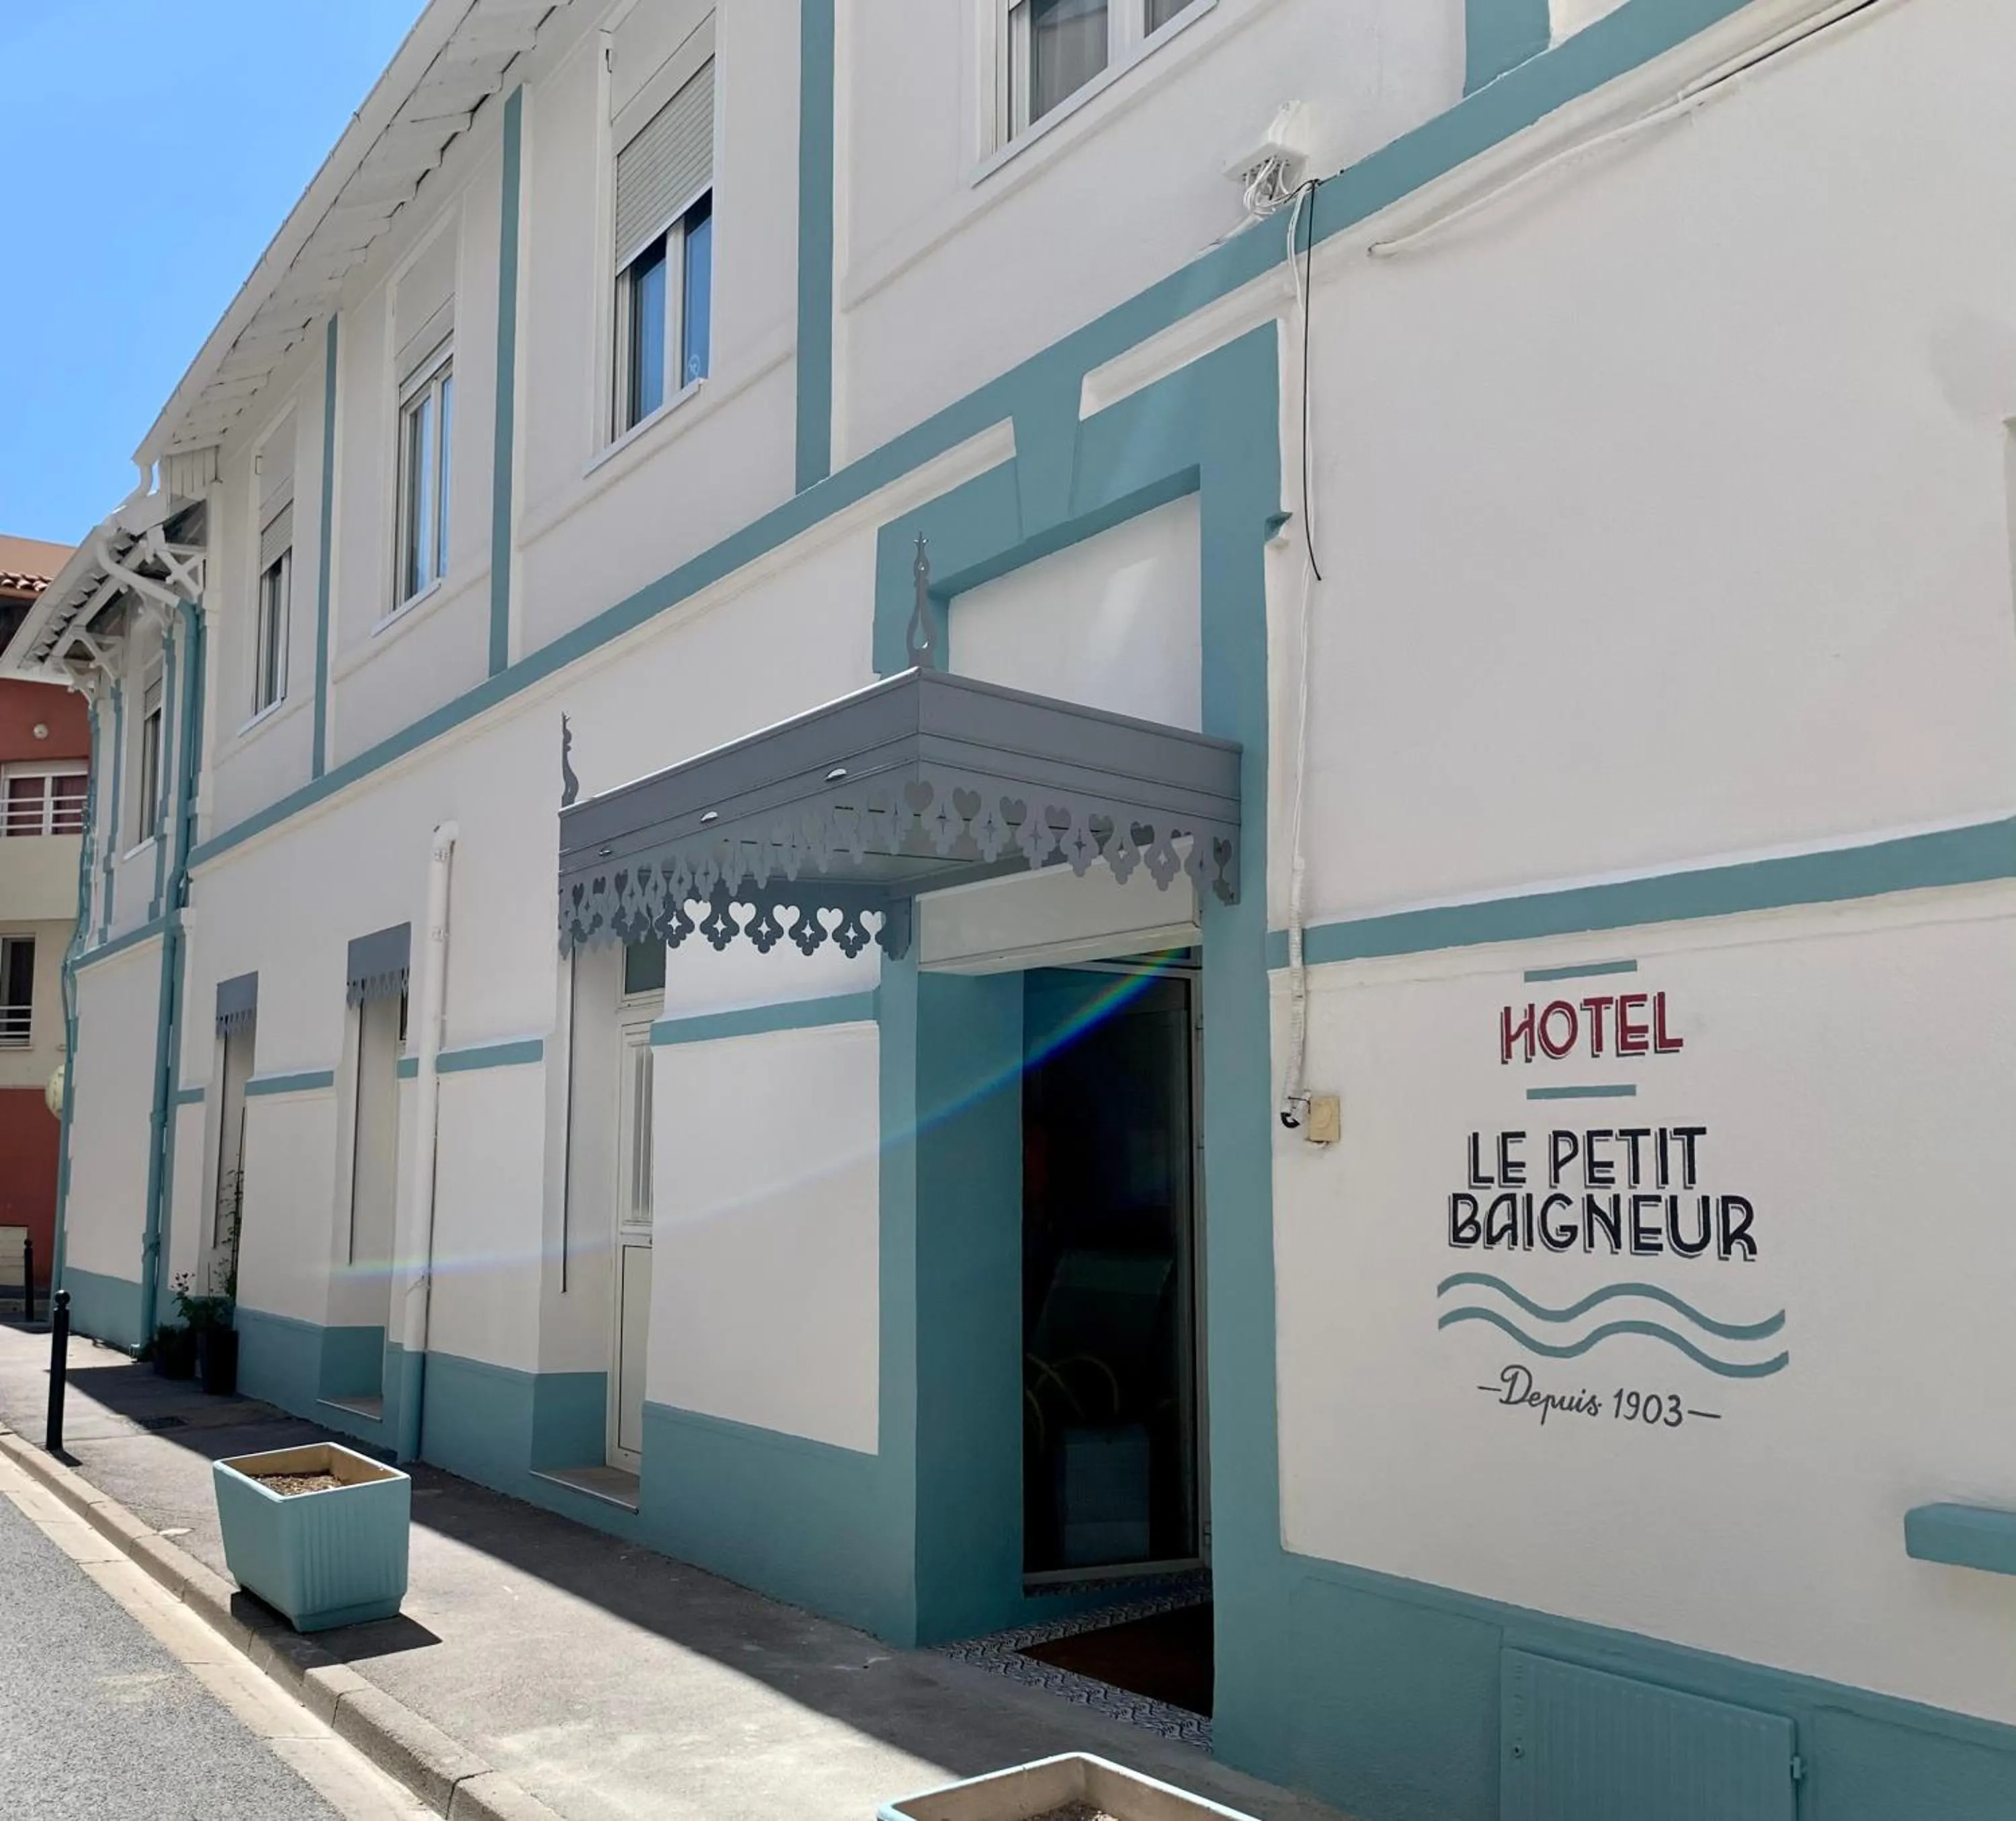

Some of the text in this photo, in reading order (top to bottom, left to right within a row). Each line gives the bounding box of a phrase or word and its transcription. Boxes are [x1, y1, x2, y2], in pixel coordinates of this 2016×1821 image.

[1501, 991, 1683, 1064] HOTEL
[1468, 1127, 1706, 1189] LE PETIT
[1448, 1192, 1758, 1263] BAIGNEUR
